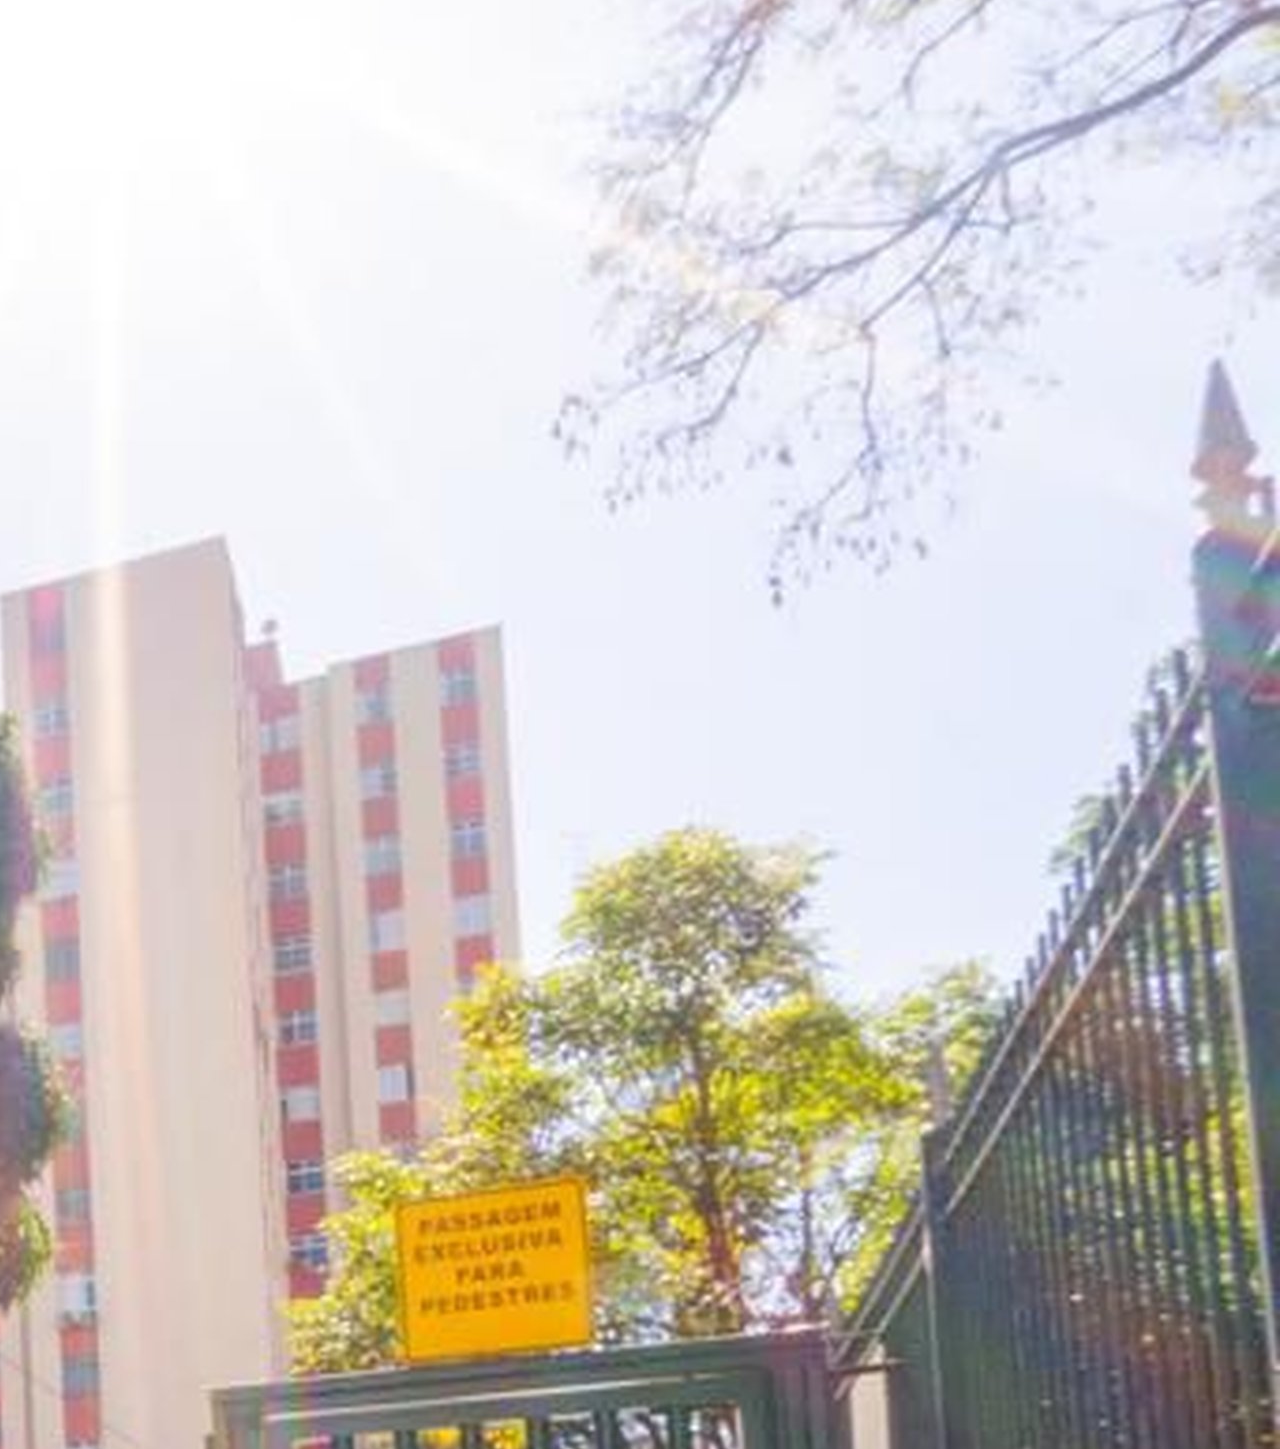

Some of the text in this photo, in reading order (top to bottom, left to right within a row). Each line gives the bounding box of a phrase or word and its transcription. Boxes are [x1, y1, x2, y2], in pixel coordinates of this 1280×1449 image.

[418, 1201, 562, 1236] PASSAGEM
[413, 1227, 563, 1265] EXCLUSIVA
[455, 1259, 525, 1285] PARA
[419, 1281, 574, 1315] PEDESTRES
